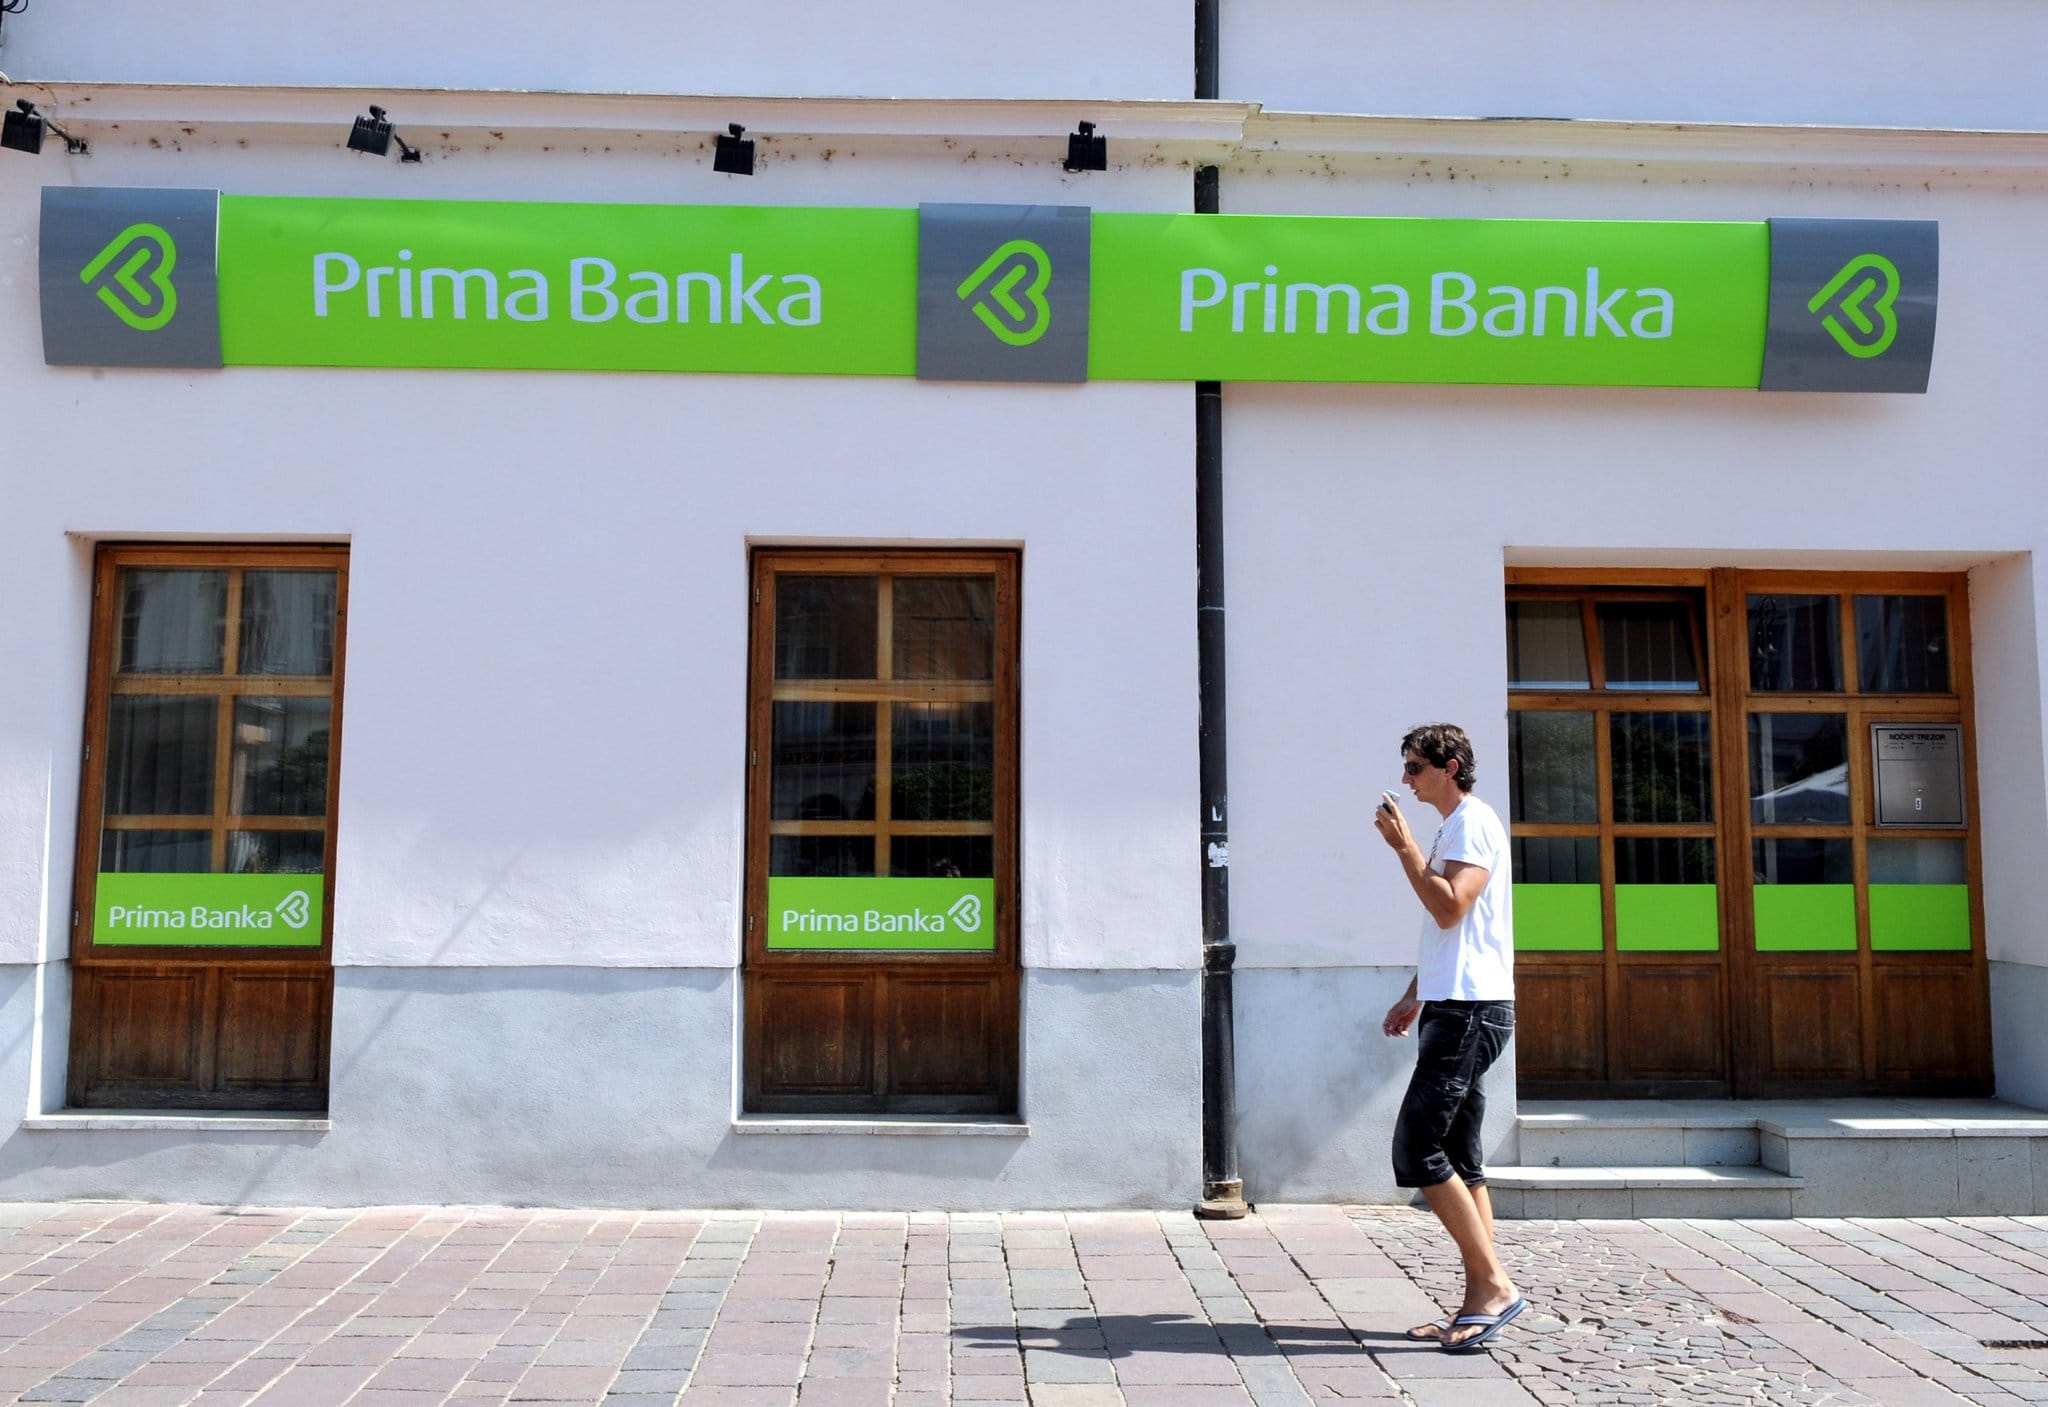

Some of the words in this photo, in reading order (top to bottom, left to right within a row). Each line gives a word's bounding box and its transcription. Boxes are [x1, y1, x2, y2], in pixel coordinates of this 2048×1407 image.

[312, 248, 549, 322] Prima
[569, 252, 822, 327] Banka
[1180, 264, 1410, 336] Prima
[1429, 266, 1674, 339] Banka
[1917, 733, 1946, 741] TREZOR
[109, 904, 186, 929] Prima
[190, 904, 273, 929] Banka
[782, 908, 859, 933] Prima
[863, 908, 945, 933] Banka
